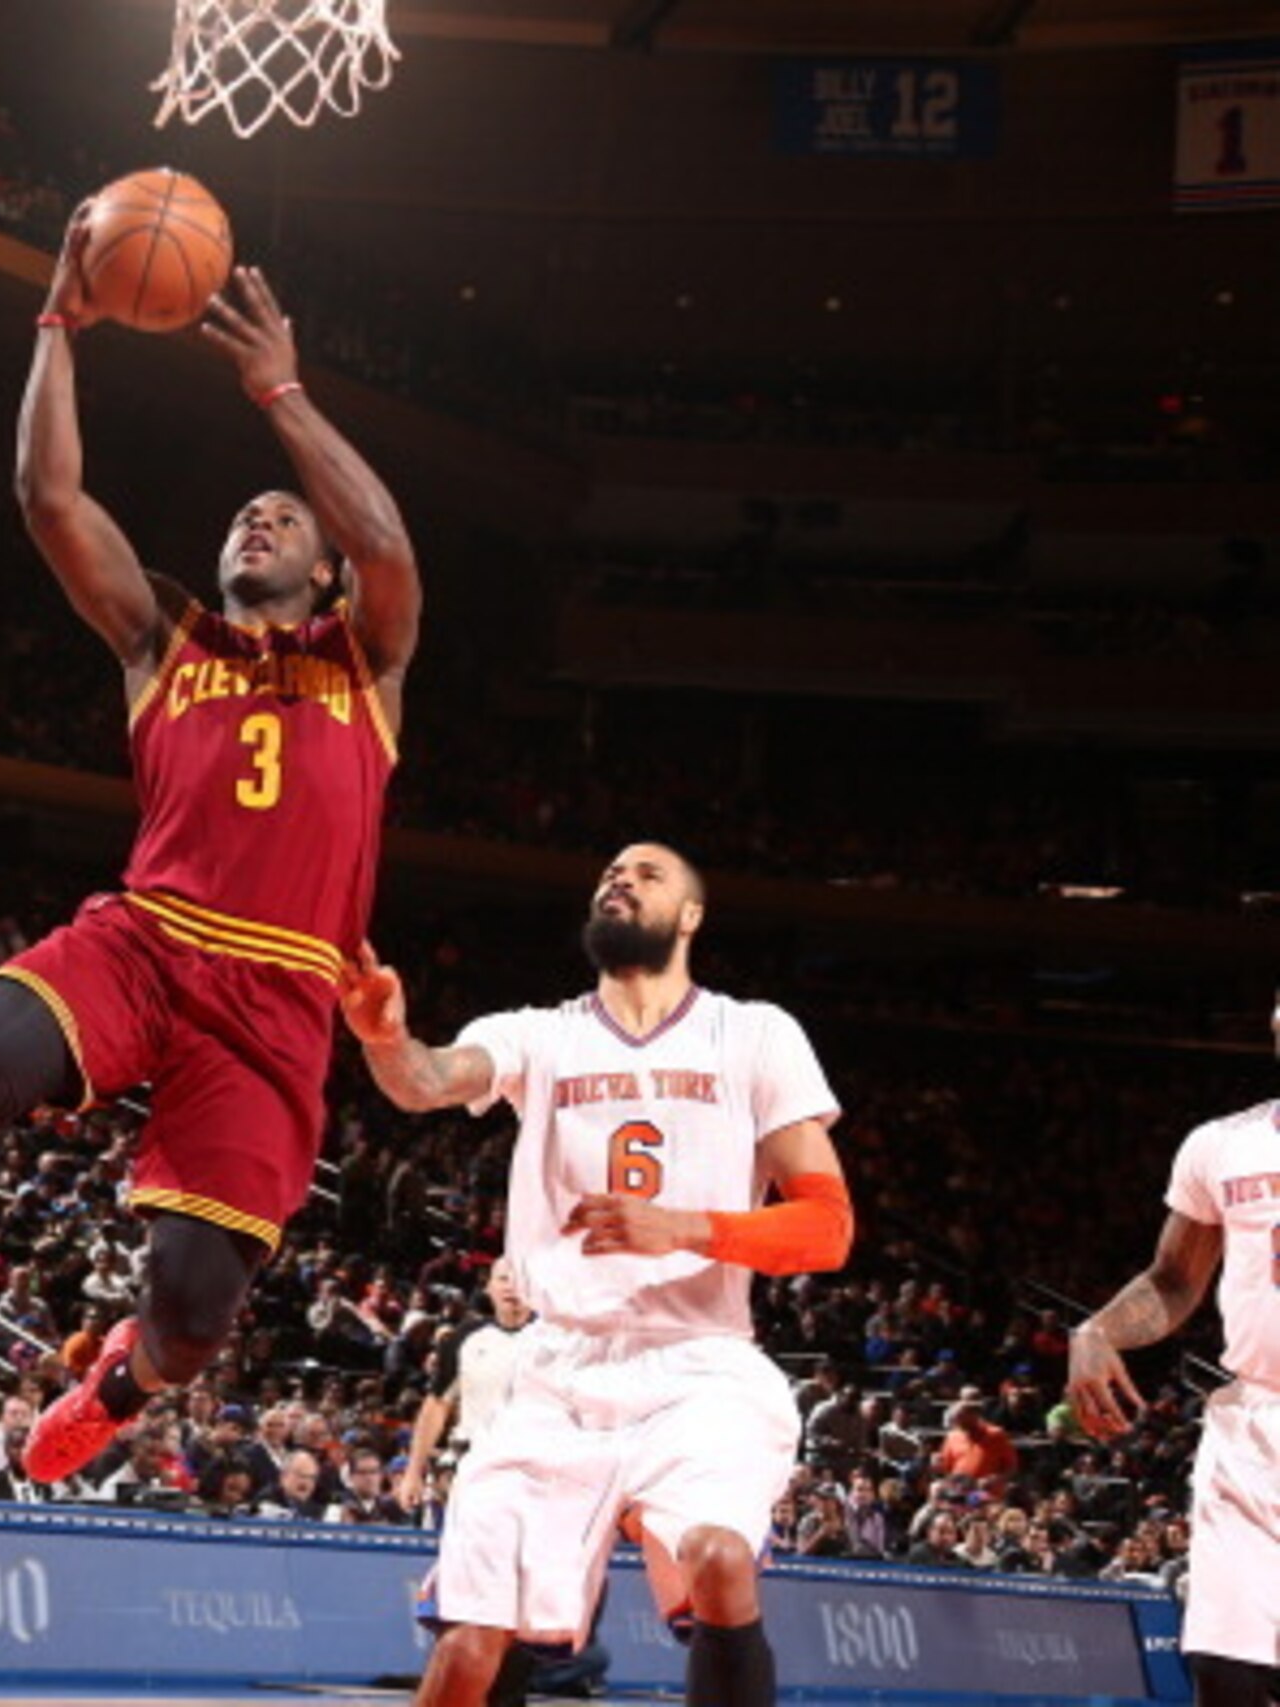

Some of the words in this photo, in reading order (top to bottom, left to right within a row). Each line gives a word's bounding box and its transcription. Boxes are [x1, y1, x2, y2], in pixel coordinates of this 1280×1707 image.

[889, 67, 961, 138] 12
[1216, 105, 1246, 175] 1
[235, 712, 282, 810] 3
[650, 1067, 719, 1105] YORK
[607, 1119, 665, 1202] 6
[164, 1586, 304, 1634] TEQUILA
[819, 1601, 919, 1671] 1800
